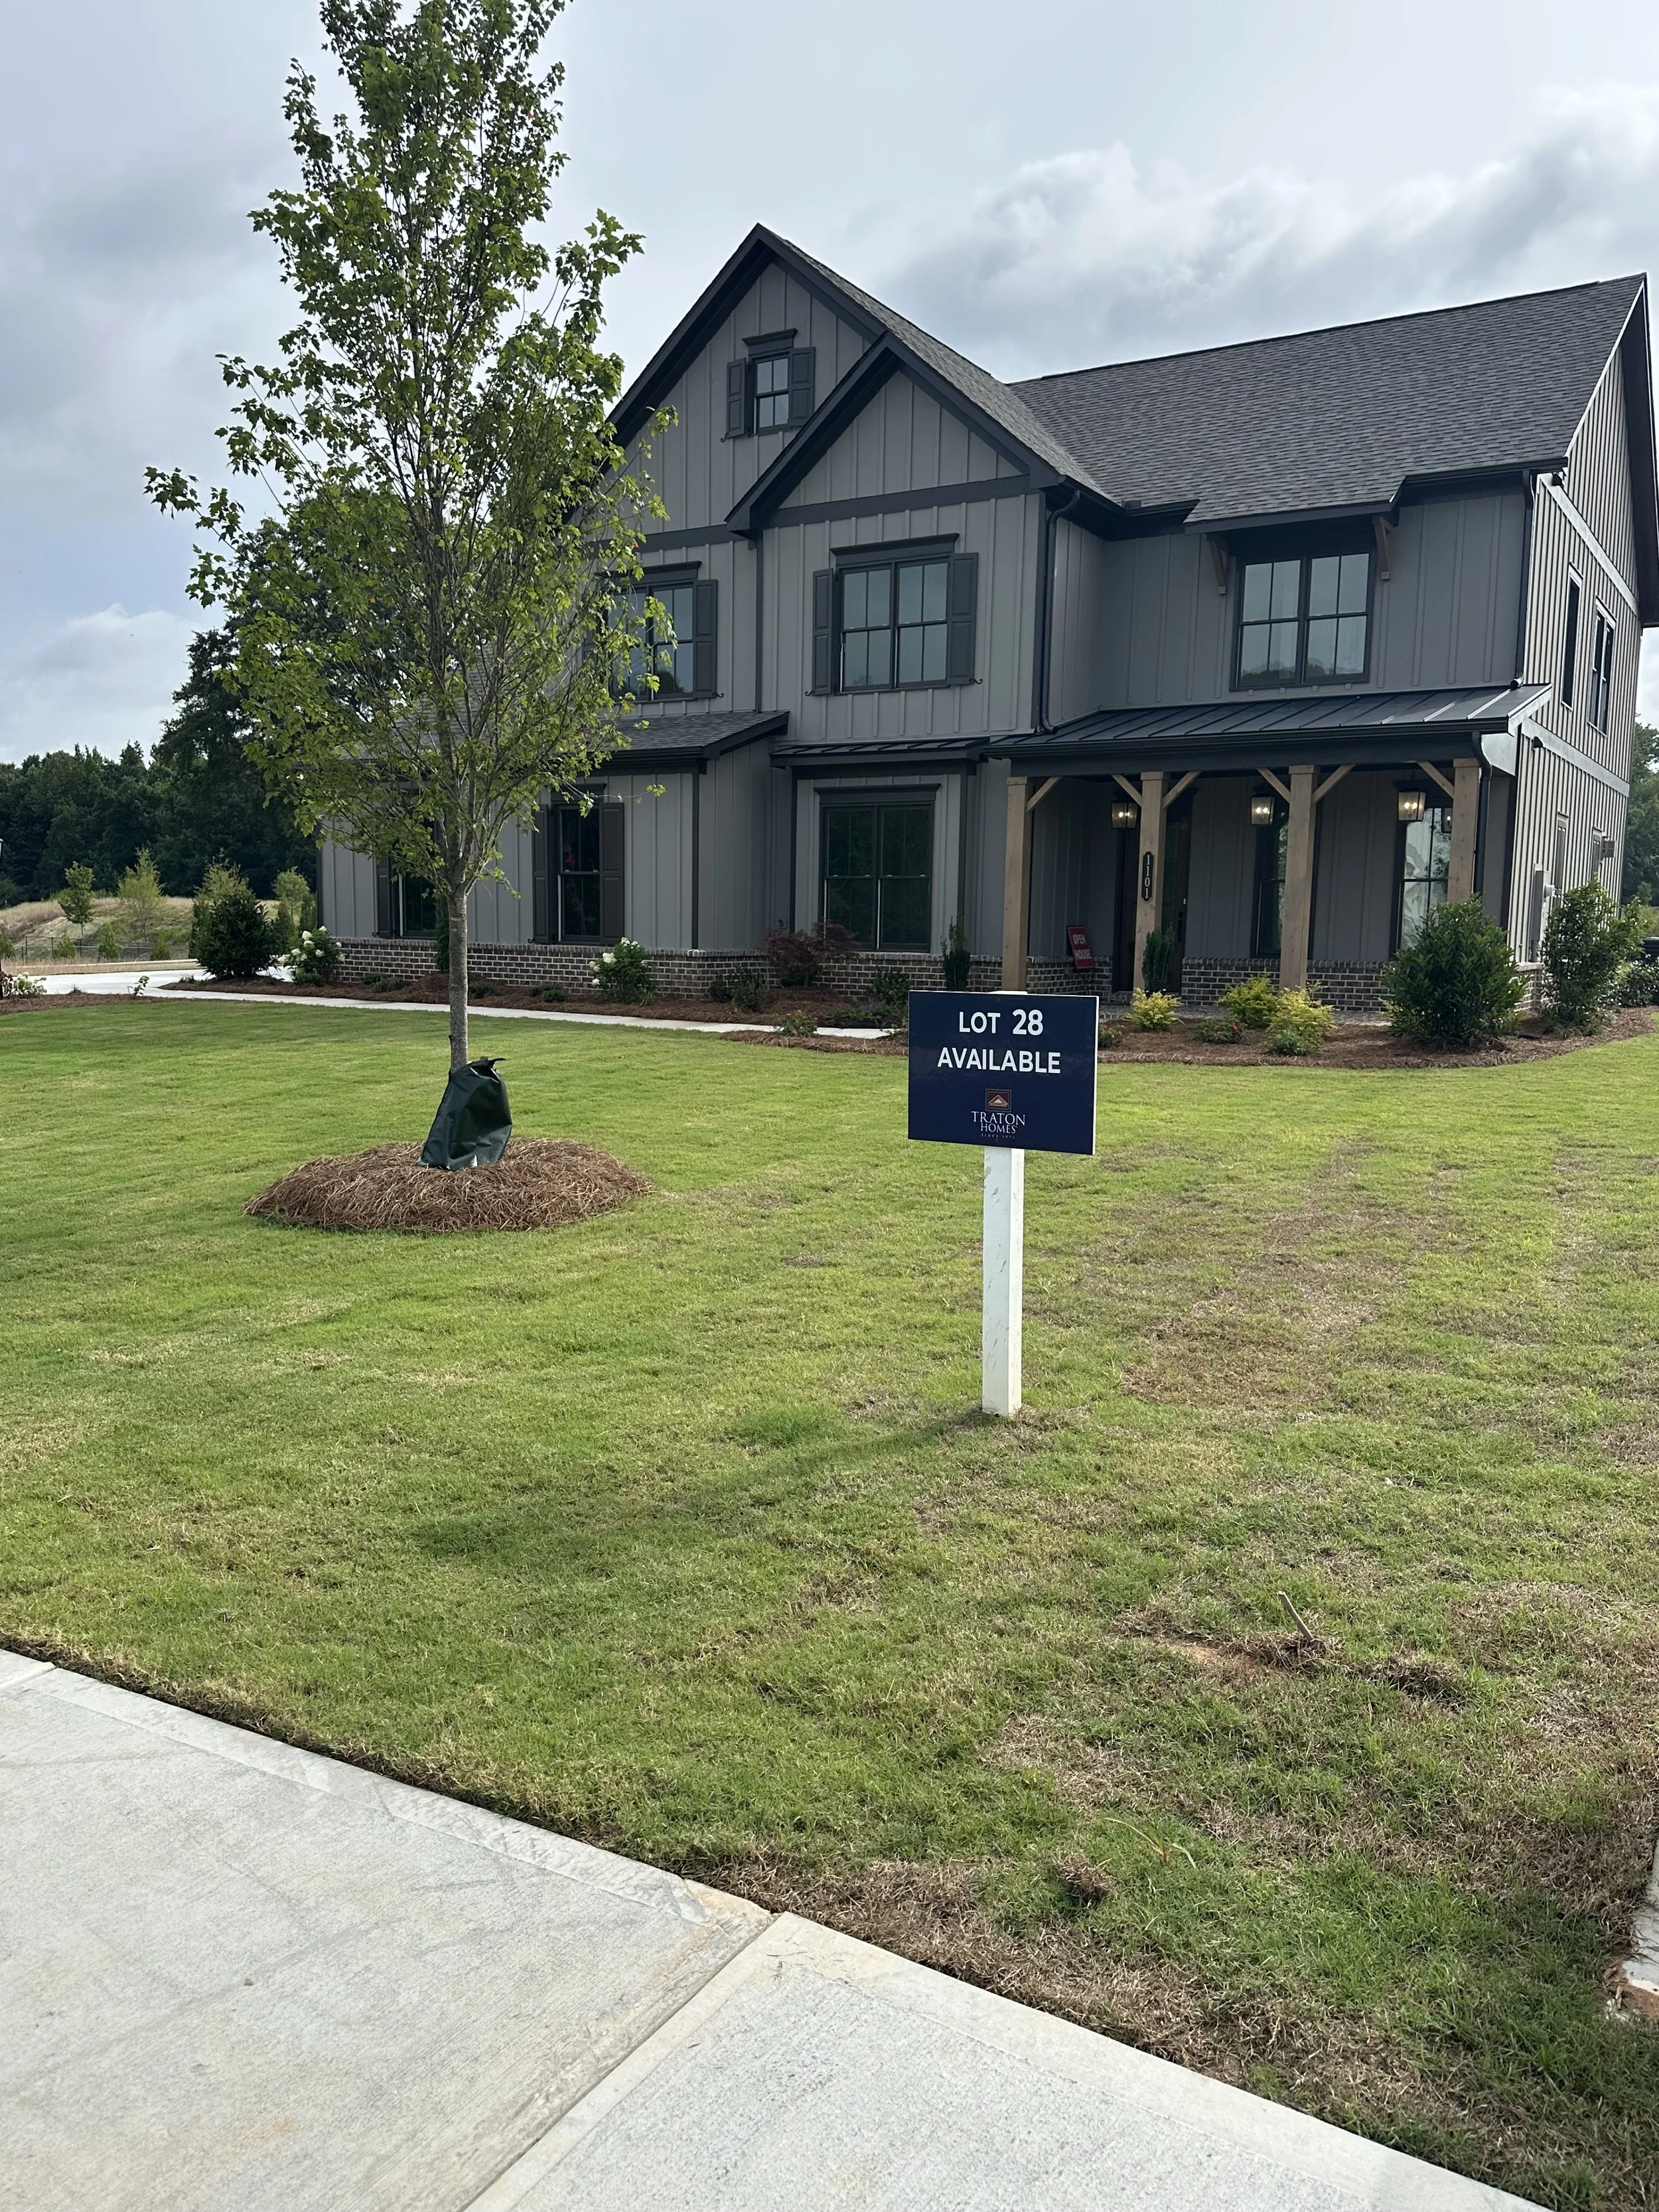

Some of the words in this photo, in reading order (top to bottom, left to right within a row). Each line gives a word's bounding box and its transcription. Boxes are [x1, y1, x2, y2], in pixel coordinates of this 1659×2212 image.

[1072, 934, 1086, 944] OPEN
[1074, 949, 1092, 960] HOUSE
[959, 1011, 1001, 1034] LOT
[1012, 1009, 1044, 1036] 28
[937, 1047, 1061, 1074] AVAILABLE
[971, 1110, 1026, 1126] TRATON
[980, 1122, 1016, 1134] HOMES
